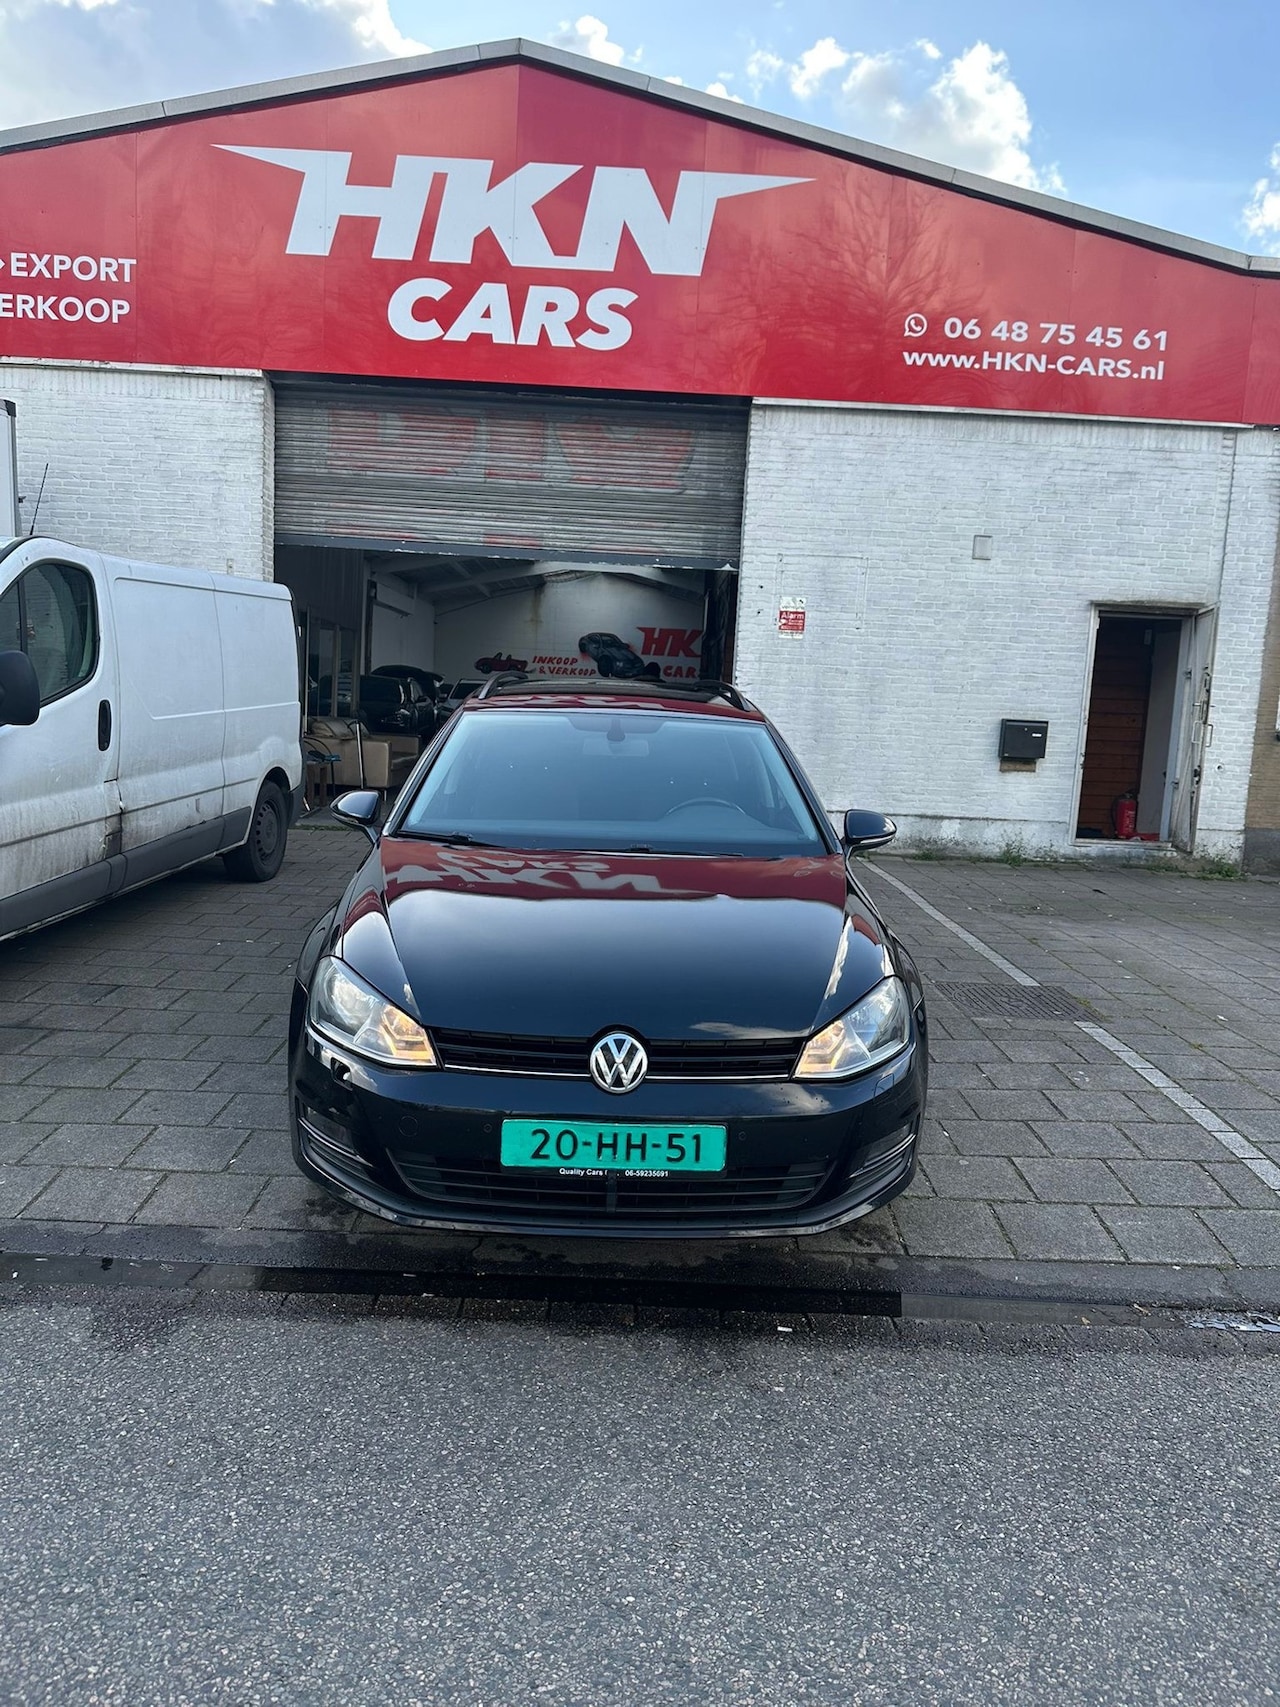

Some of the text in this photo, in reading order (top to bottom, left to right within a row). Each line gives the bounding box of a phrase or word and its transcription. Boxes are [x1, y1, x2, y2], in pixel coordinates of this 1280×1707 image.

[210, 144, 817, 276] HKN
[10, 252, 137, 283] EXPORT
[387, 277, 638, 351] CARS
[943, 317, 1168, 351] 06 48 75 45 61
[902, 350, 1165, 380] www.HKN-CARS.nl
[532, 655, 578, 666] INKOOP
[548, 666, 597, 677] VERKOOP
[530, 1128, 702, 1163] 20-HH-51
[559, 1167, 585, 1177] Quality
[586, 1168, 604, 1176] Cars
